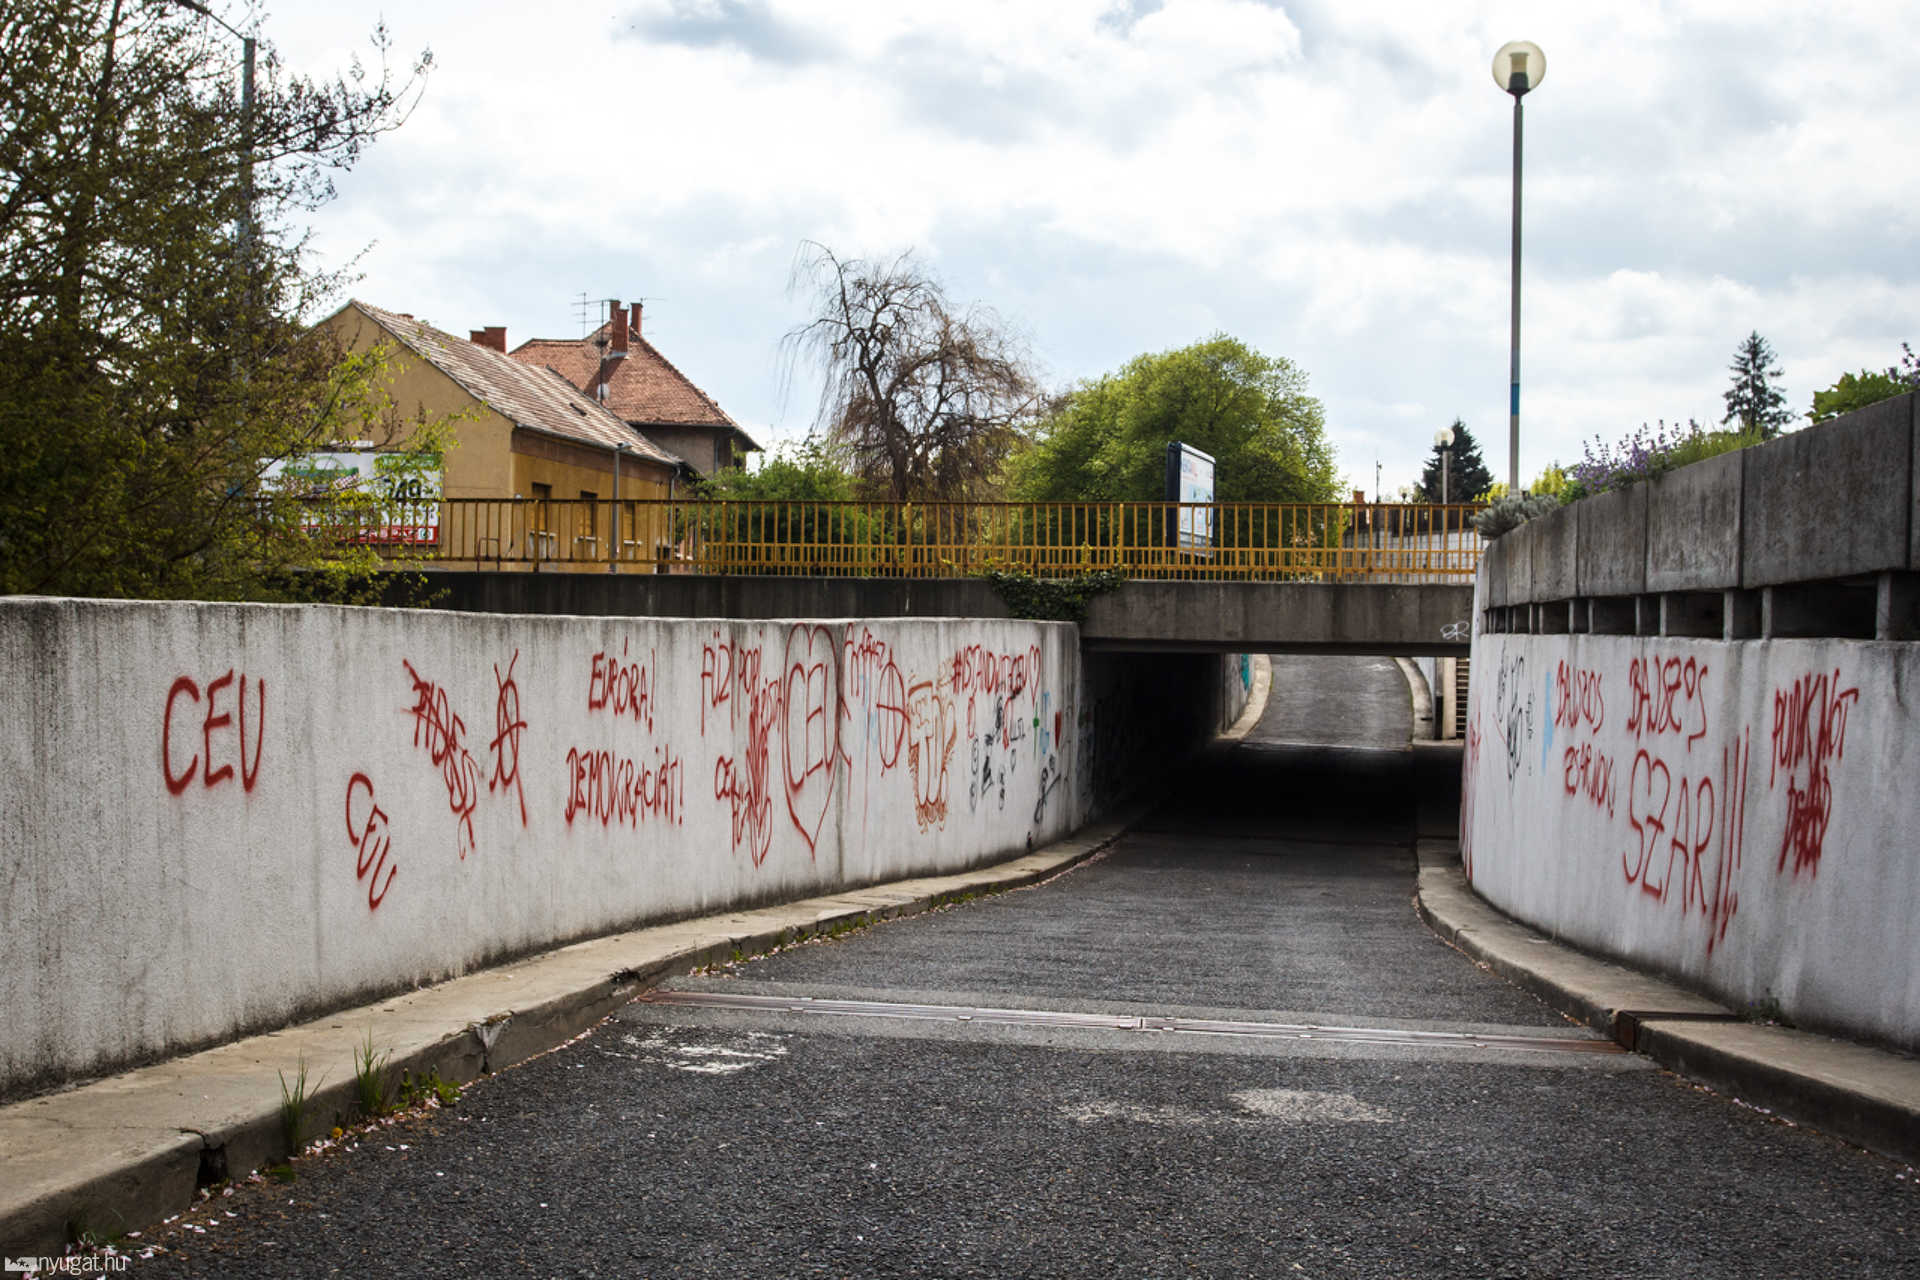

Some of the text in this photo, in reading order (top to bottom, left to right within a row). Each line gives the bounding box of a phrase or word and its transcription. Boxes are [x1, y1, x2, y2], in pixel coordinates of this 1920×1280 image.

[162, 669, 265, 796] CEU
[786, 661, 839, 796] CEU
[346, 771, 397, 912] CEU
